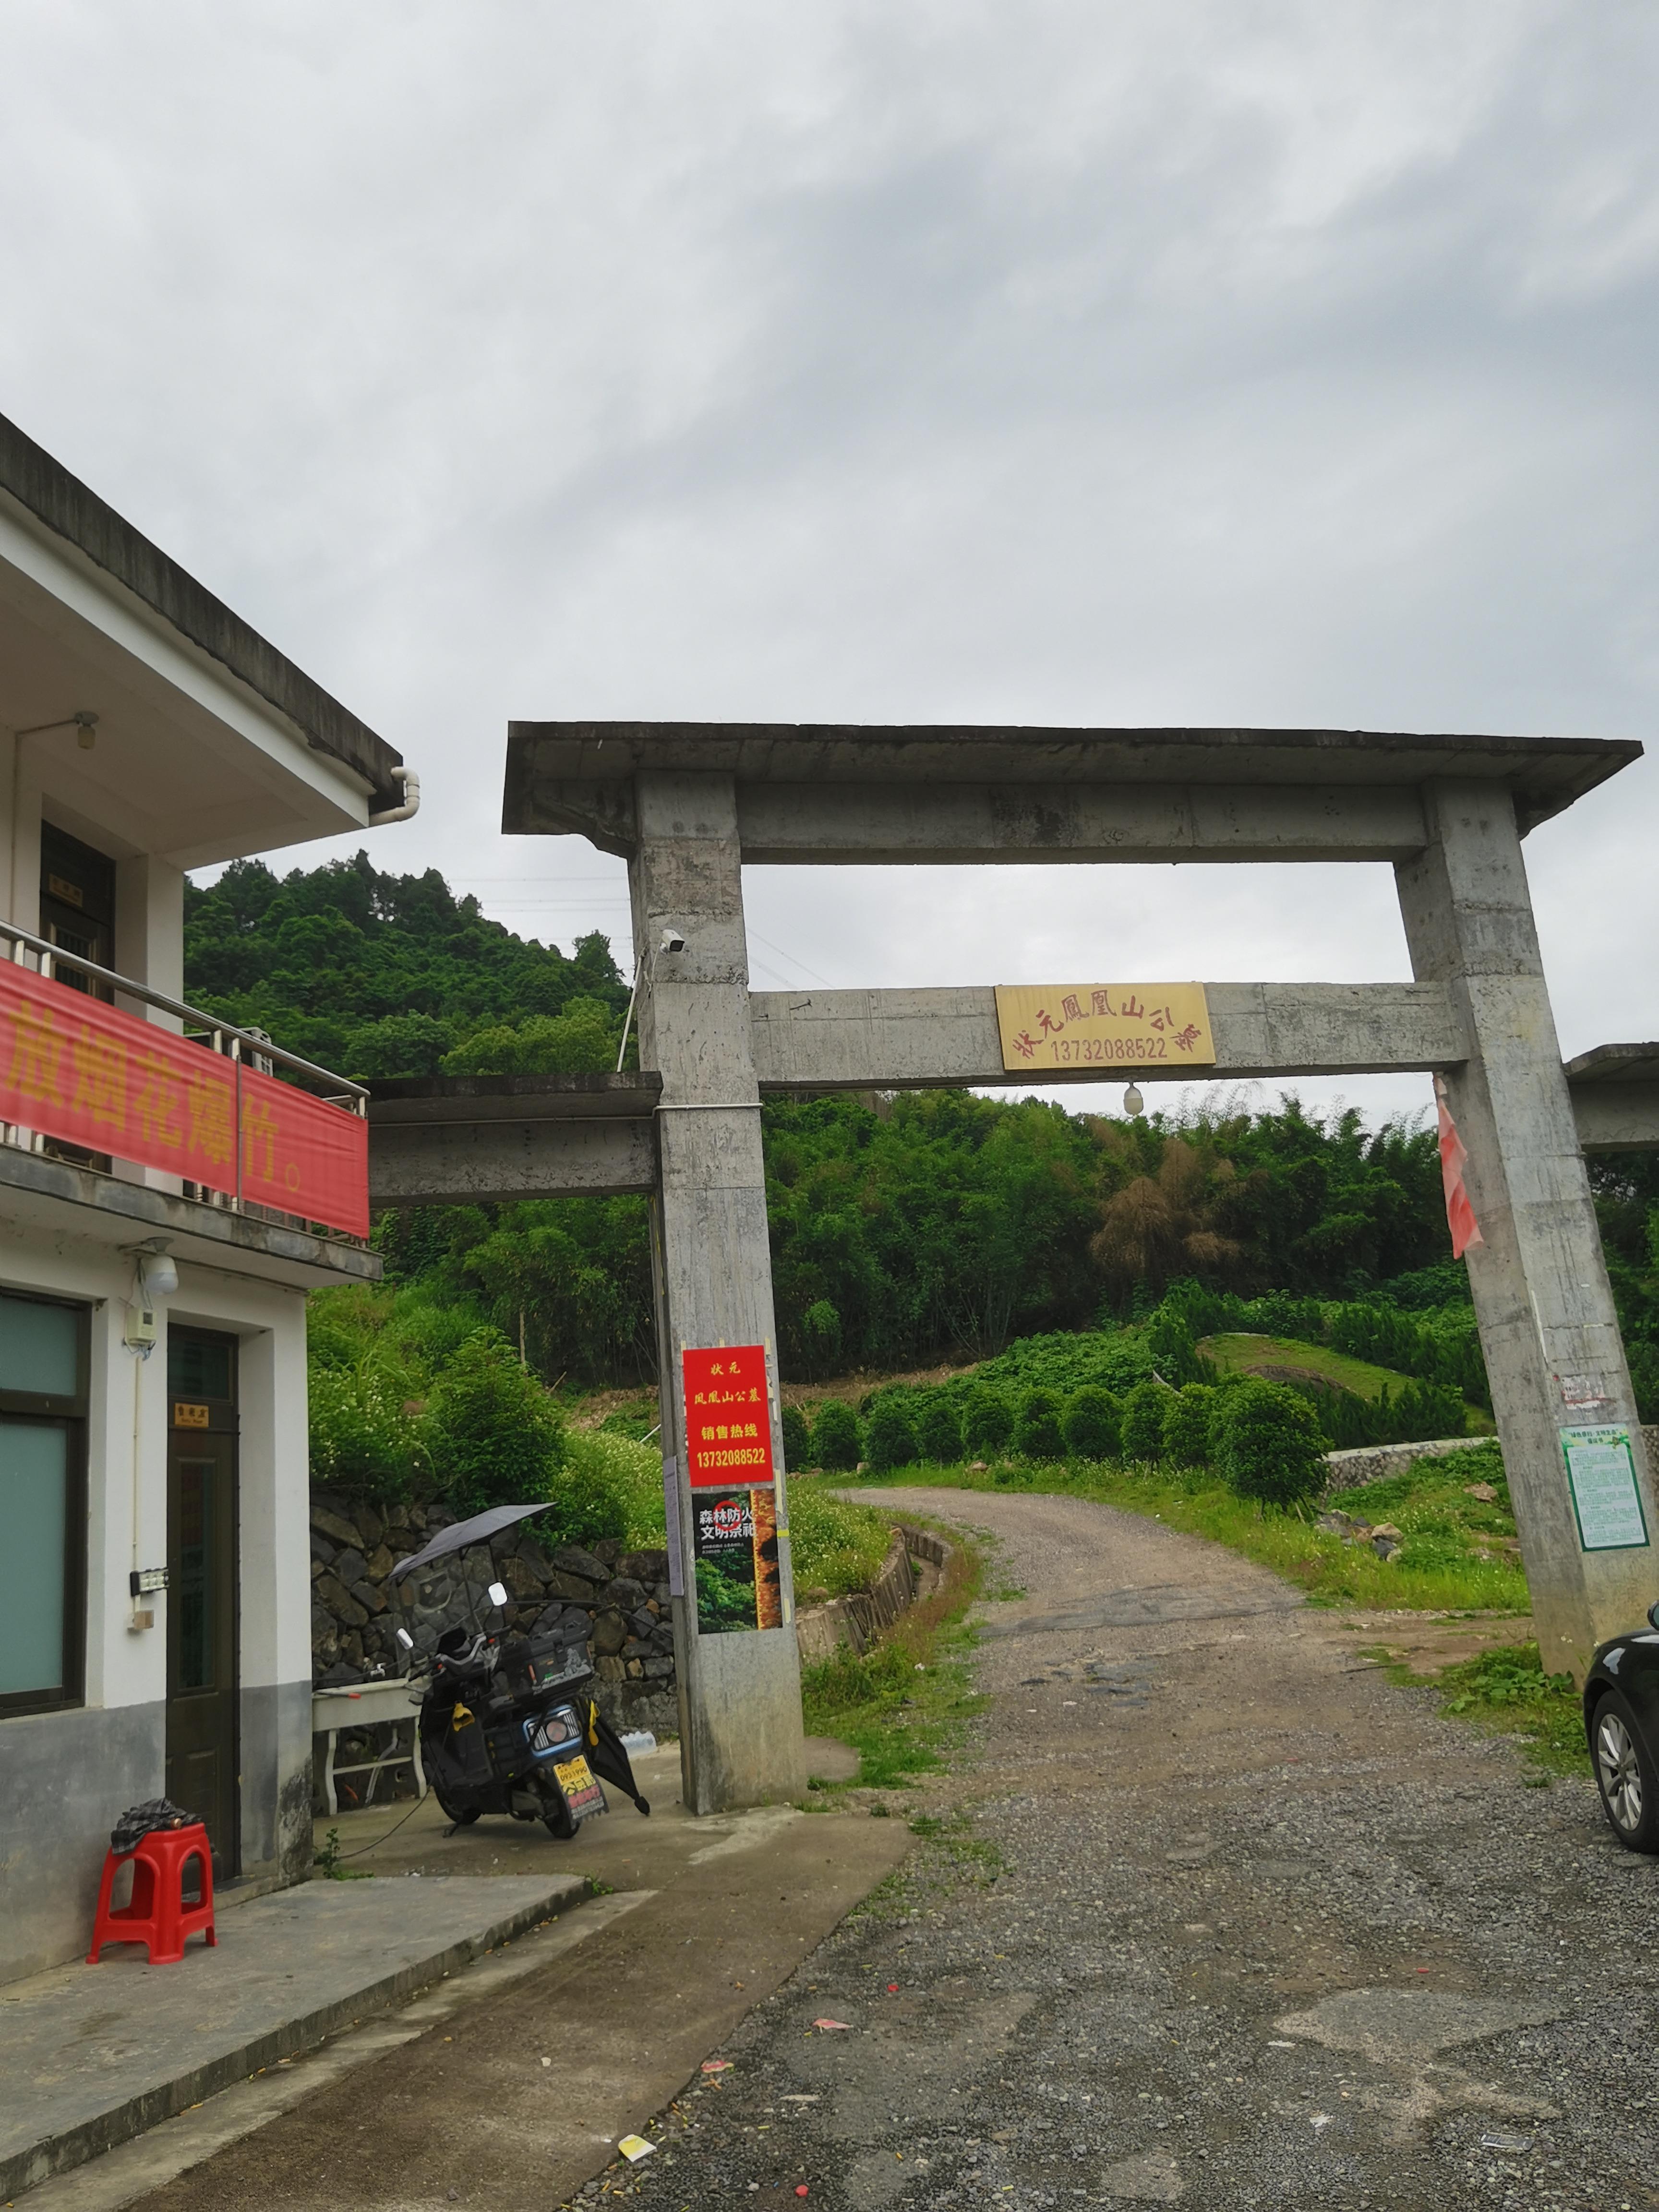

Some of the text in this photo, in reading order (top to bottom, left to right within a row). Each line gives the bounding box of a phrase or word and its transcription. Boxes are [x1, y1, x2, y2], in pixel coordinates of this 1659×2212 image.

[1051, 1037, 1167, 1062] 13732088522
[701, 1423, 757, 1440] 销售热线
[697, 1447, 766, 1468] 13732088522
[699, 1507, 755, 1525] 森林防火
